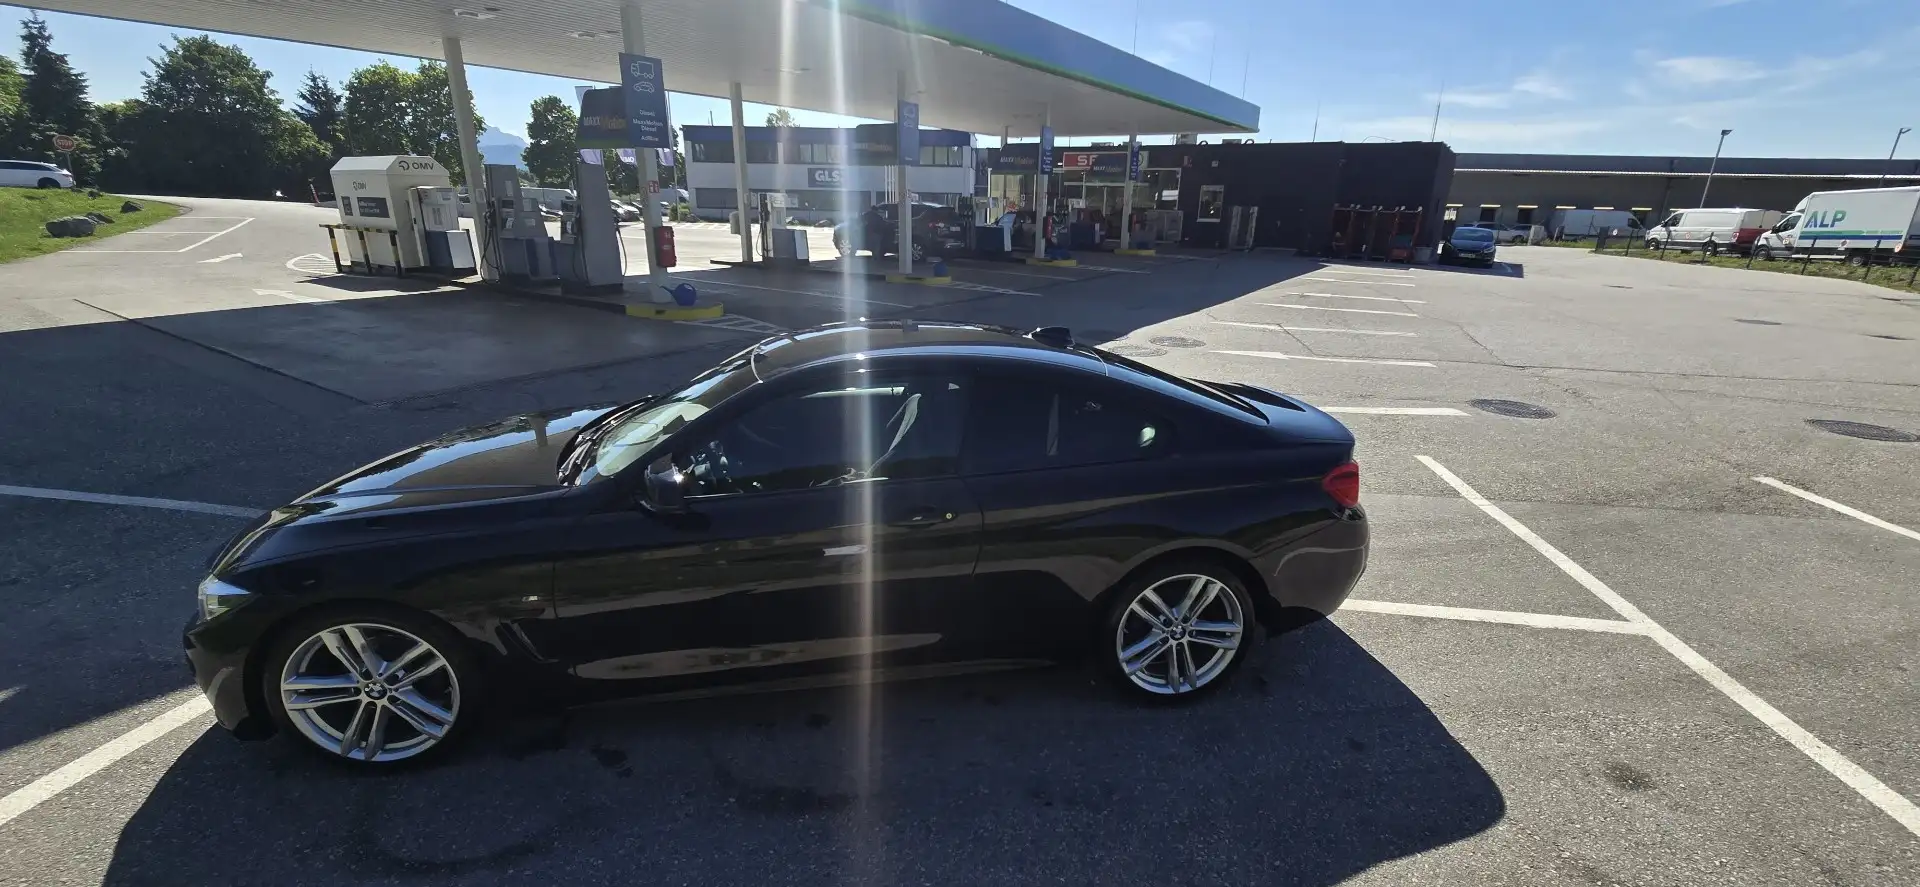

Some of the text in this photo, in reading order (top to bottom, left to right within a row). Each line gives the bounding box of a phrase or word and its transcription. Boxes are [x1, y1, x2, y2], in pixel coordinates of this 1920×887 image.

[57, 139, 73, 147] STOP
[412, 162, 434, 170] OMV
[814, 169, 841, 182] GLS
[1805, 210, 1847, 228] ALP
